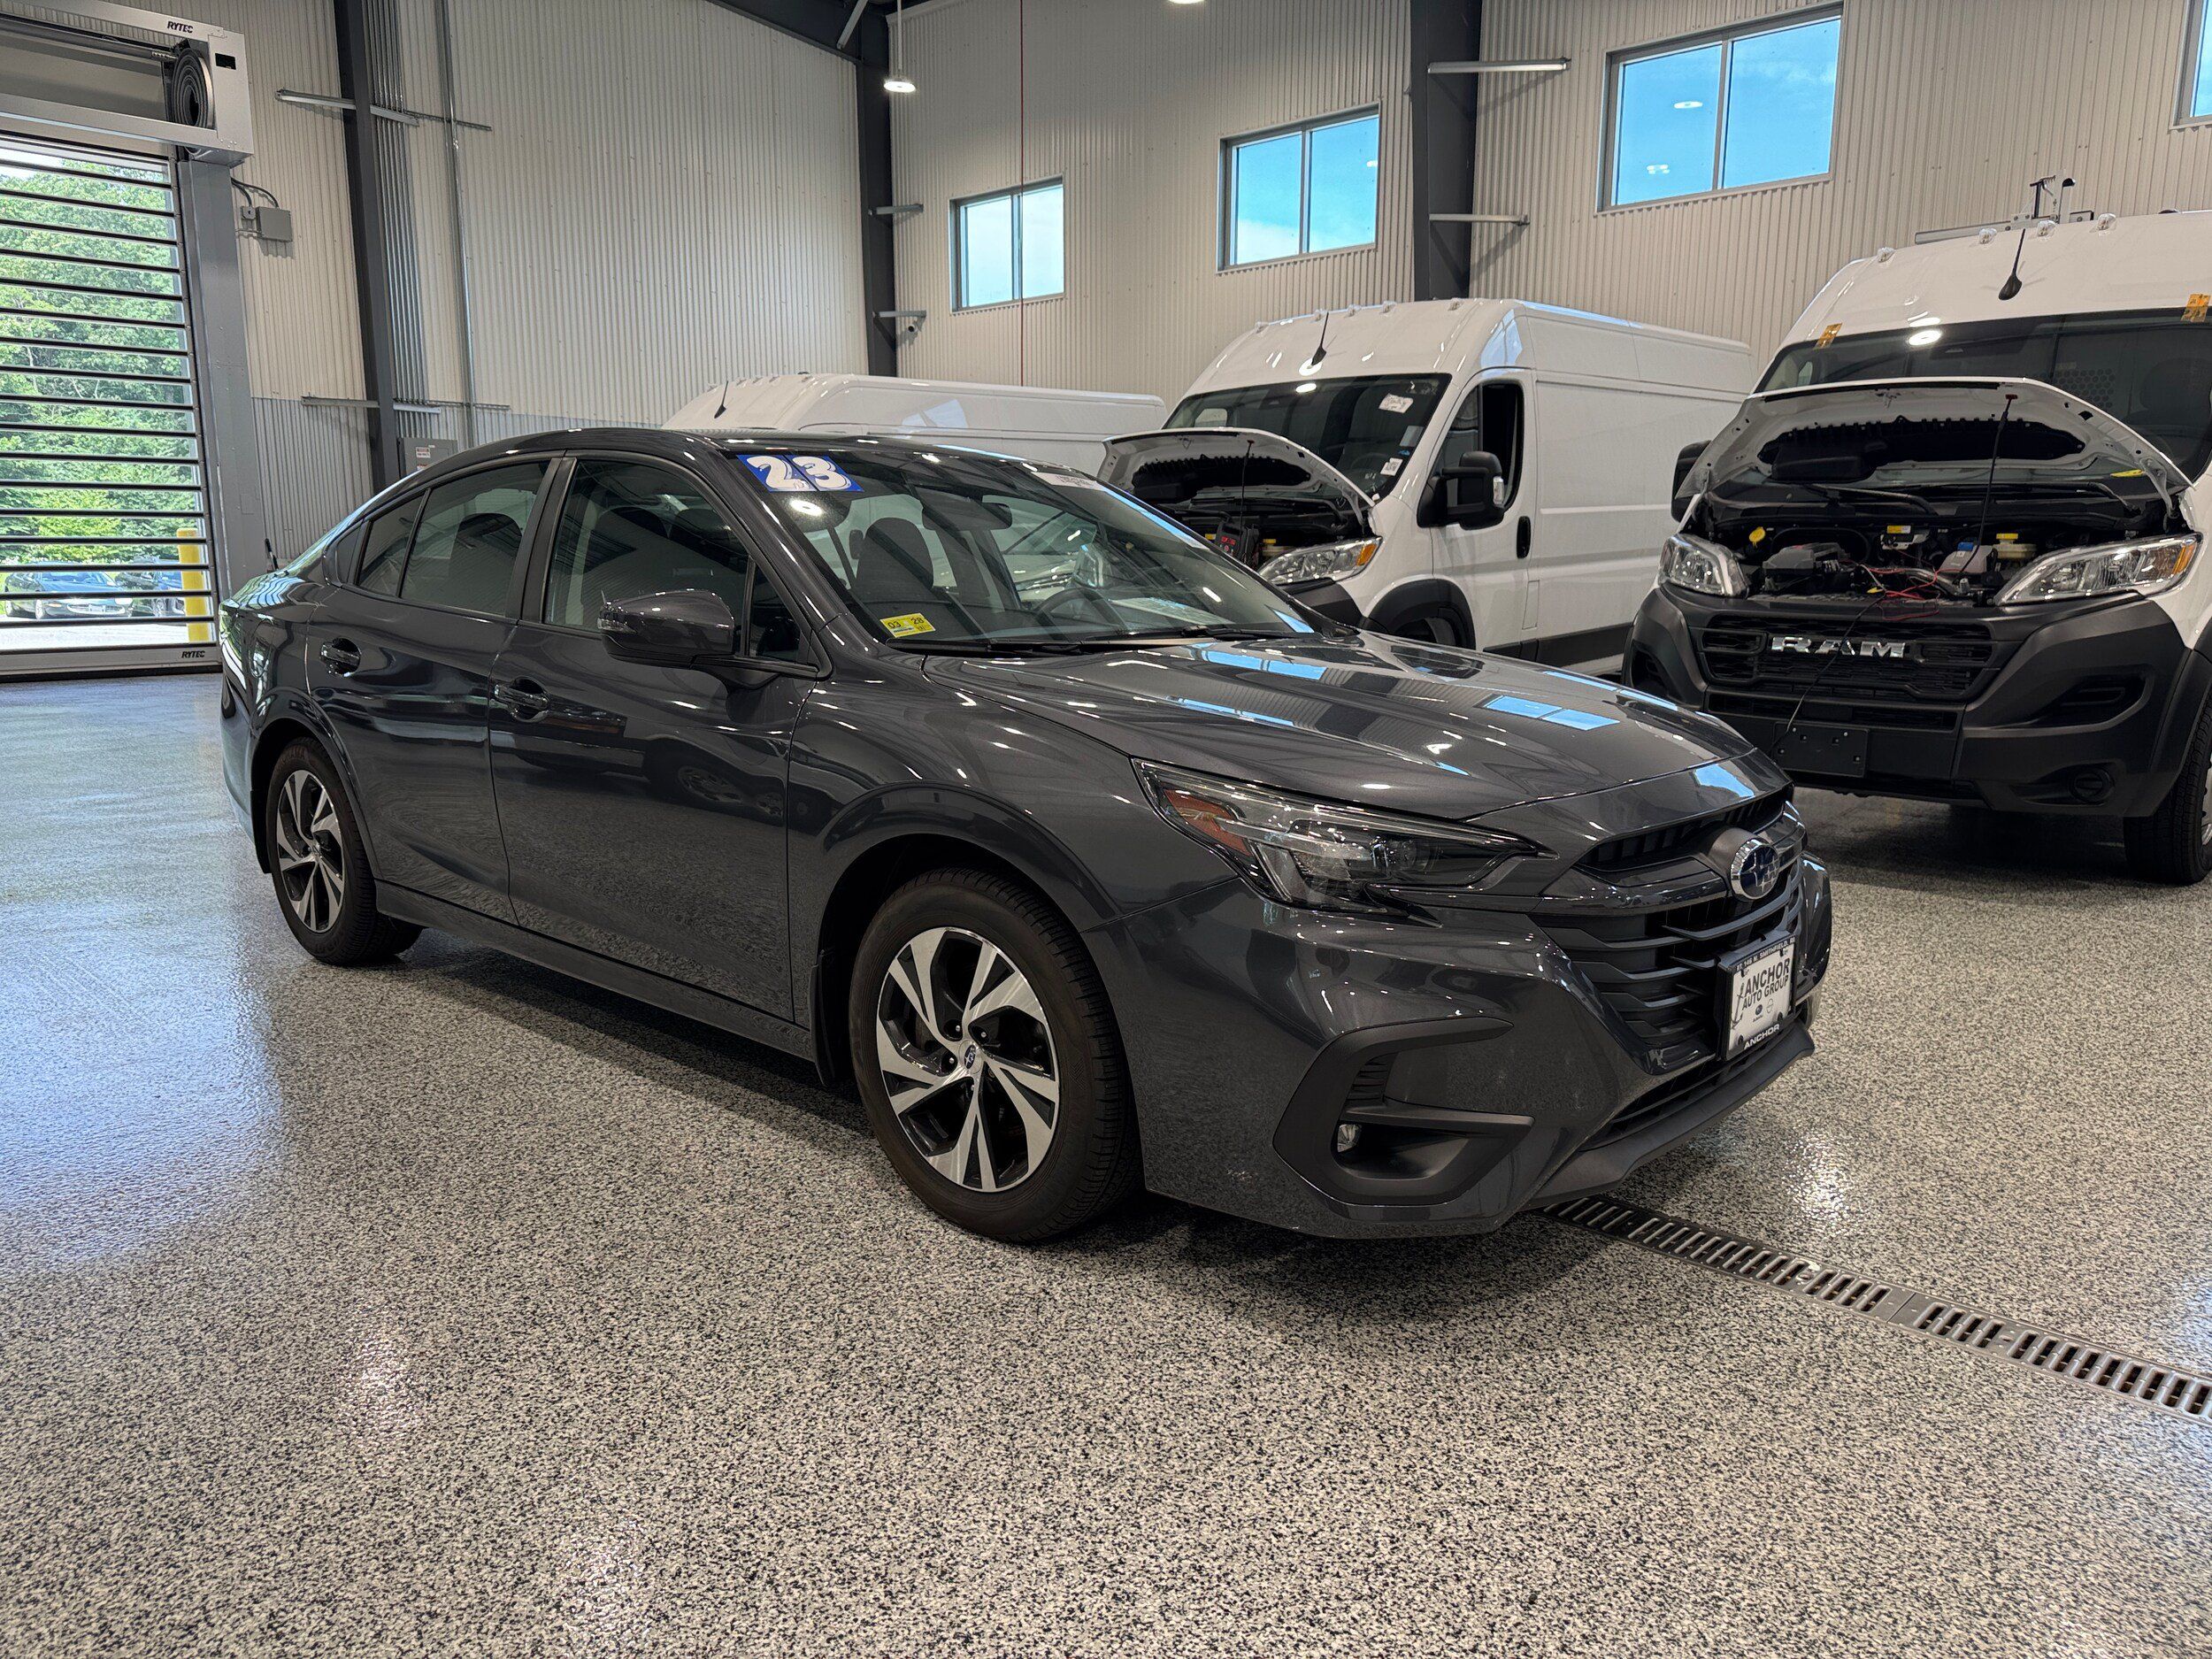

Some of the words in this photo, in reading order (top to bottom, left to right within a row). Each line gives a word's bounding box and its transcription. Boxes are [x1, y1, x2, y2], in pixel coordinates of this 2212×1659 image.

[167, 21, 193, 34] RYTEC
[746, 456, 851, 489] 23
[1771, 636, 1905, 658] RAM
[1745, 957, 1790, 997] ANCHOR
[1742, 991, 1763, 1010] AUTO
[1764, 975, 1789, 997] GROUP
[1744, 1023, 1780, 1049] ANCHOR
